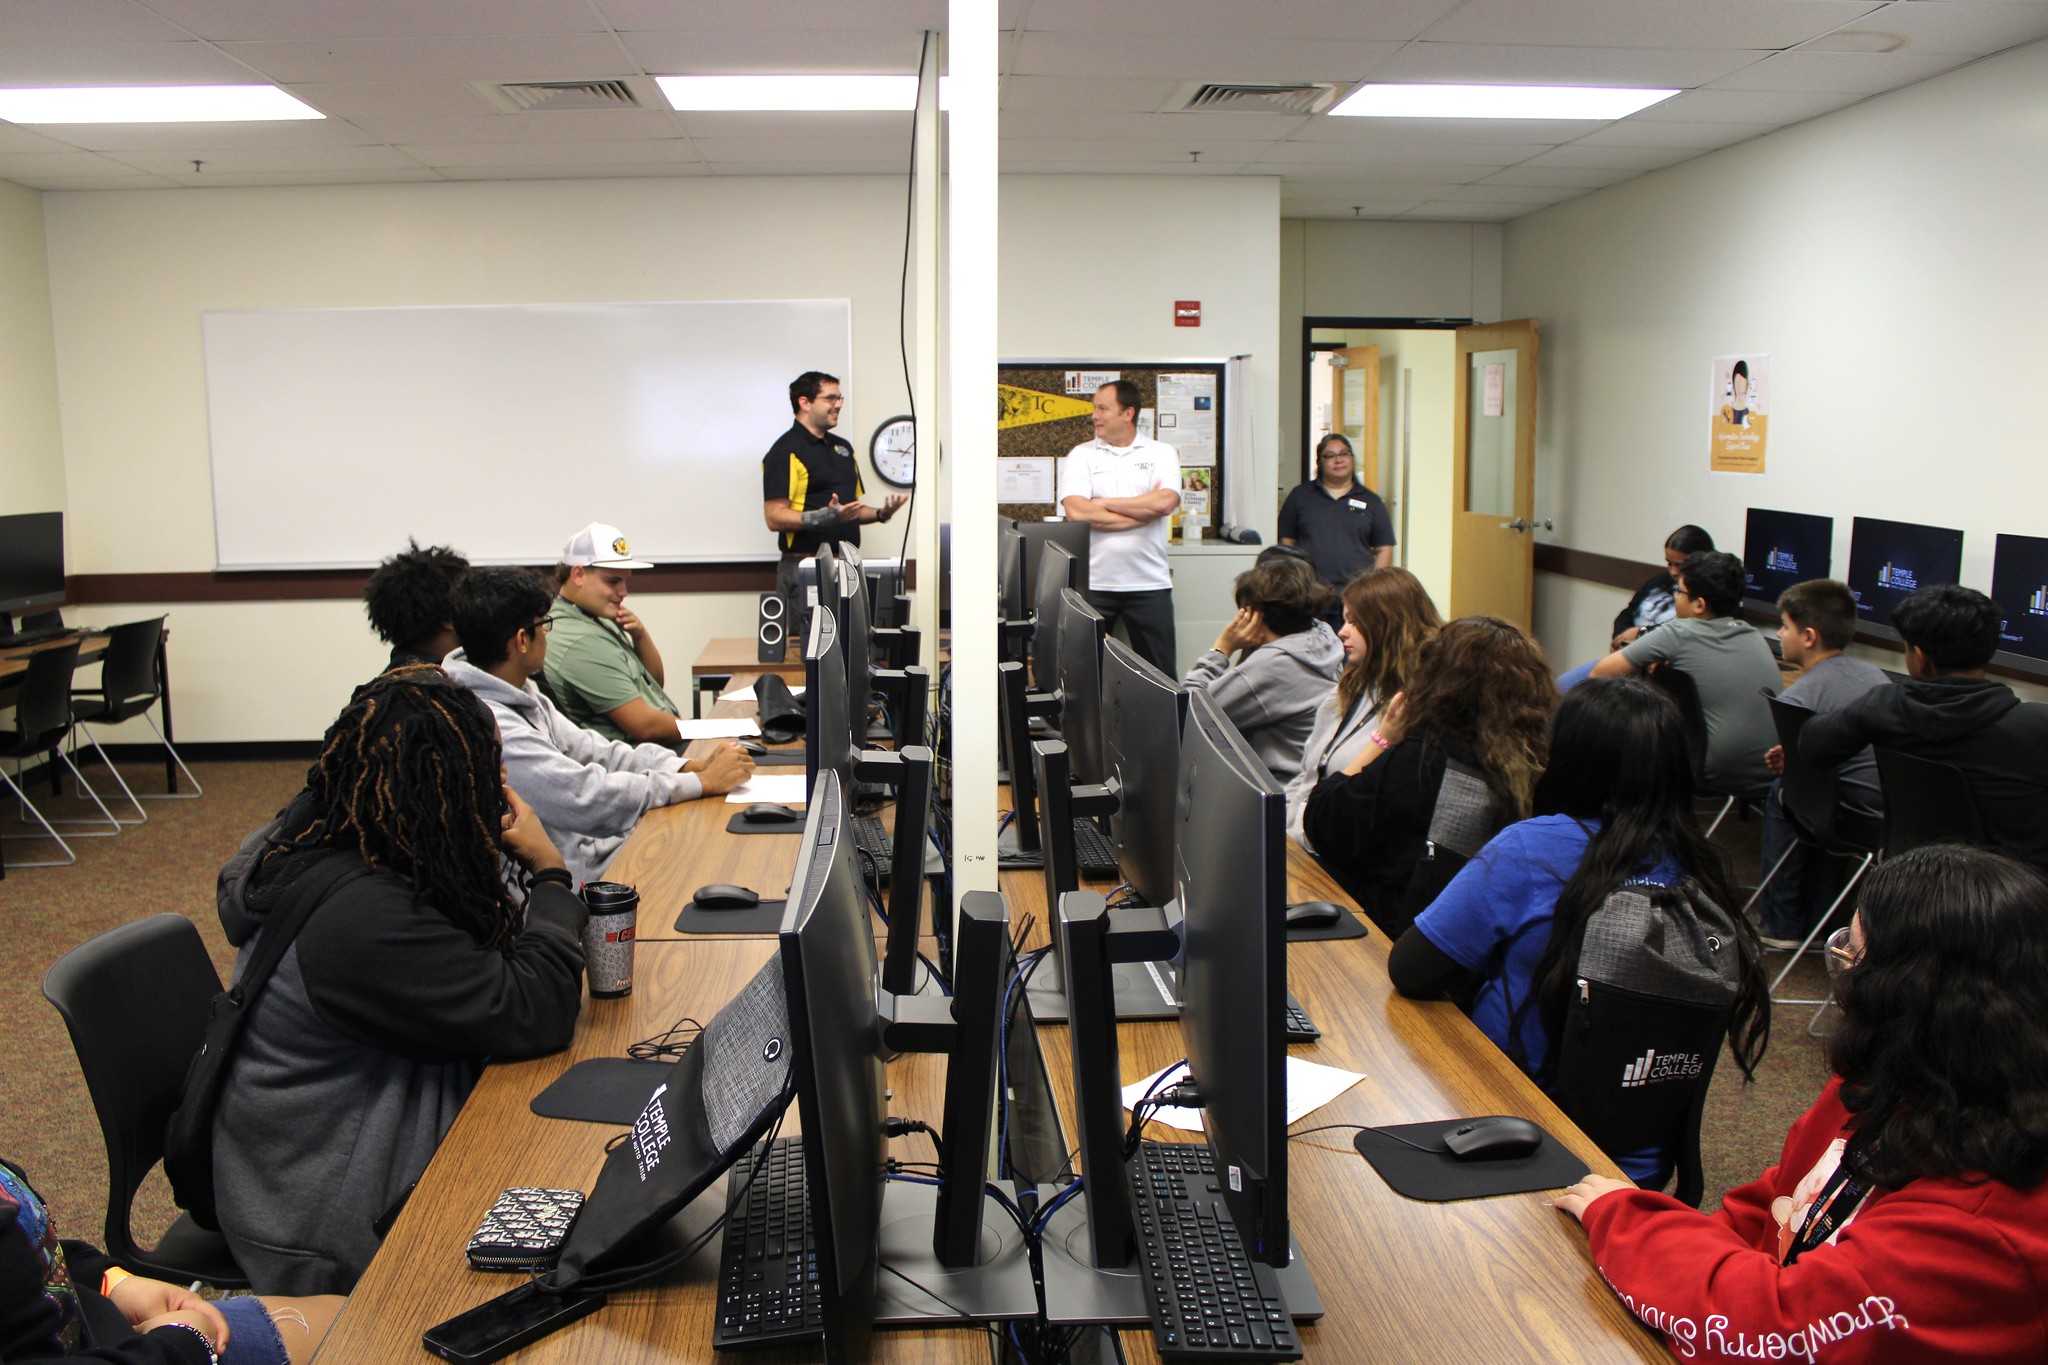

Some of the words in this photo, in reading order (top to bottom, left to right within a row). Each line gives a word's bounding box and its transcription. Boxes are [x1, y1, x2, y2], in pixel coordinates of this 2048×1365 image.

[1032, 395, 1055, 414] TC
[892, 428, 899, 436] 11
[1891, 567, 1913, 579] TEMPLE
[1890, 576, 1918, 589] COLLEGE
[1656, 1053, 1700, 1066] TEMPLE
[1650, 1063, 1704, 1078] COLLEGE
[648, 1098, 671, 1151] TEMPLE
[636, 1112, 660, 1172] COLLEGE
